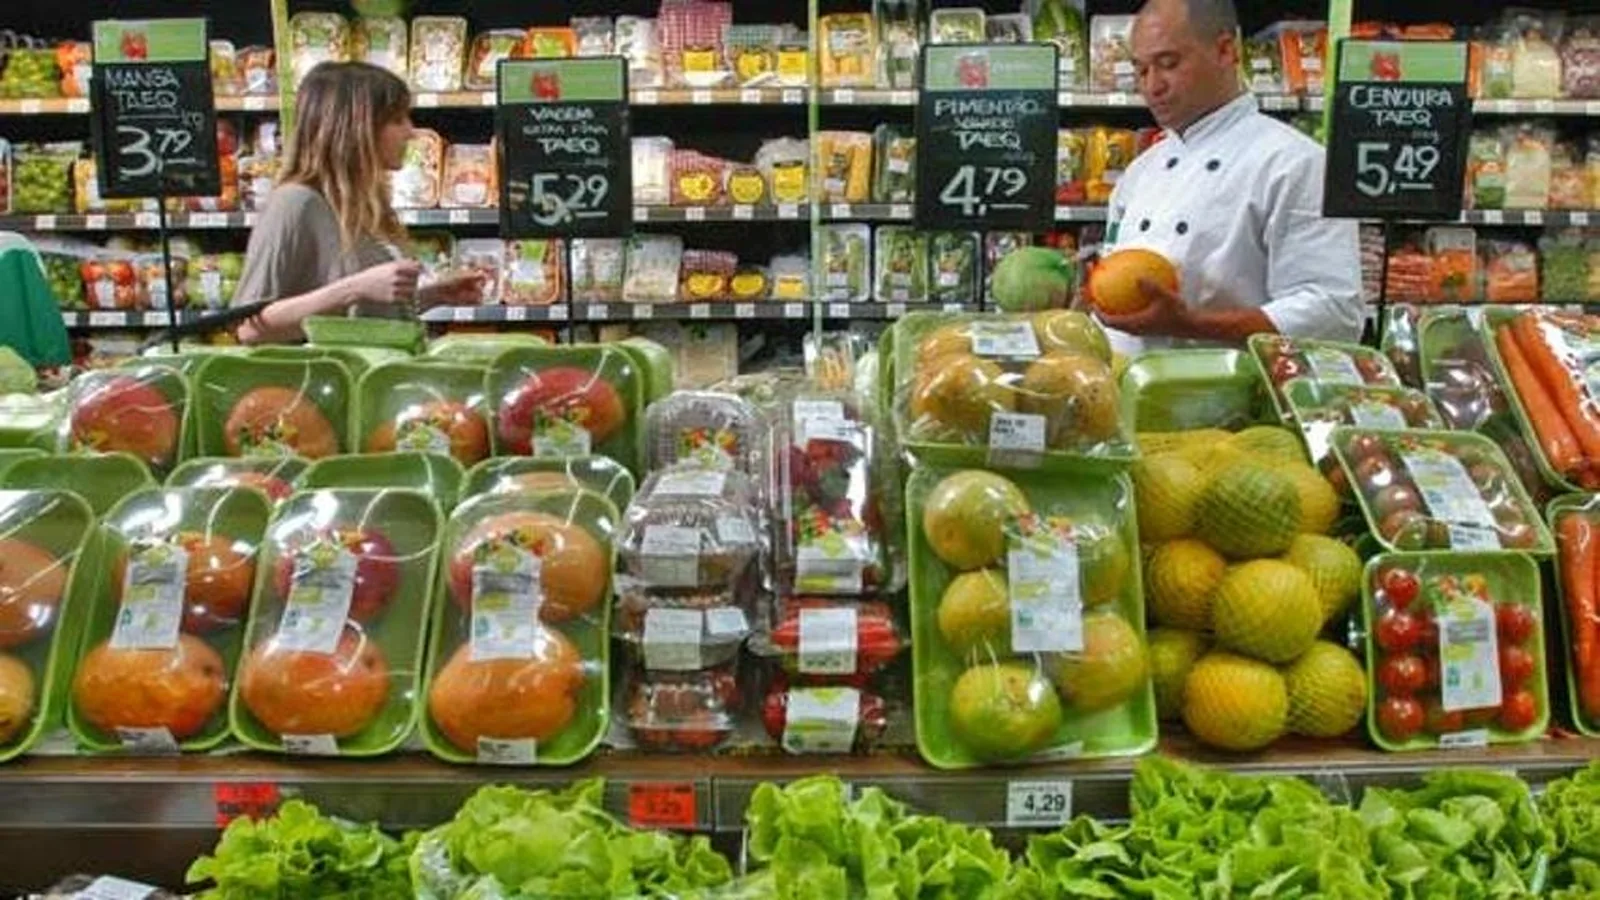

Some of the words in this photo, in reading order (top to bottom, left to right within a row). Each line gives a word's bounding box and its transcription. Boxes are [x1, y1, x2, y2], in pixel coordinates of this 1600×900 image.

[105, 68, 180, 88] MANGA
[111, 90, 178, 110] TAEQ
[1349, 85, 1454, 108] CENOURA
[1369, 109, 1433, 127] TAEQ
[536, 137, 601, 155] TAEQ
[951, 129, 1021, 150] TAEQ
[1356, 142, 1440, 197] 5,49
[939, 165, 1028, 216] 4,79
